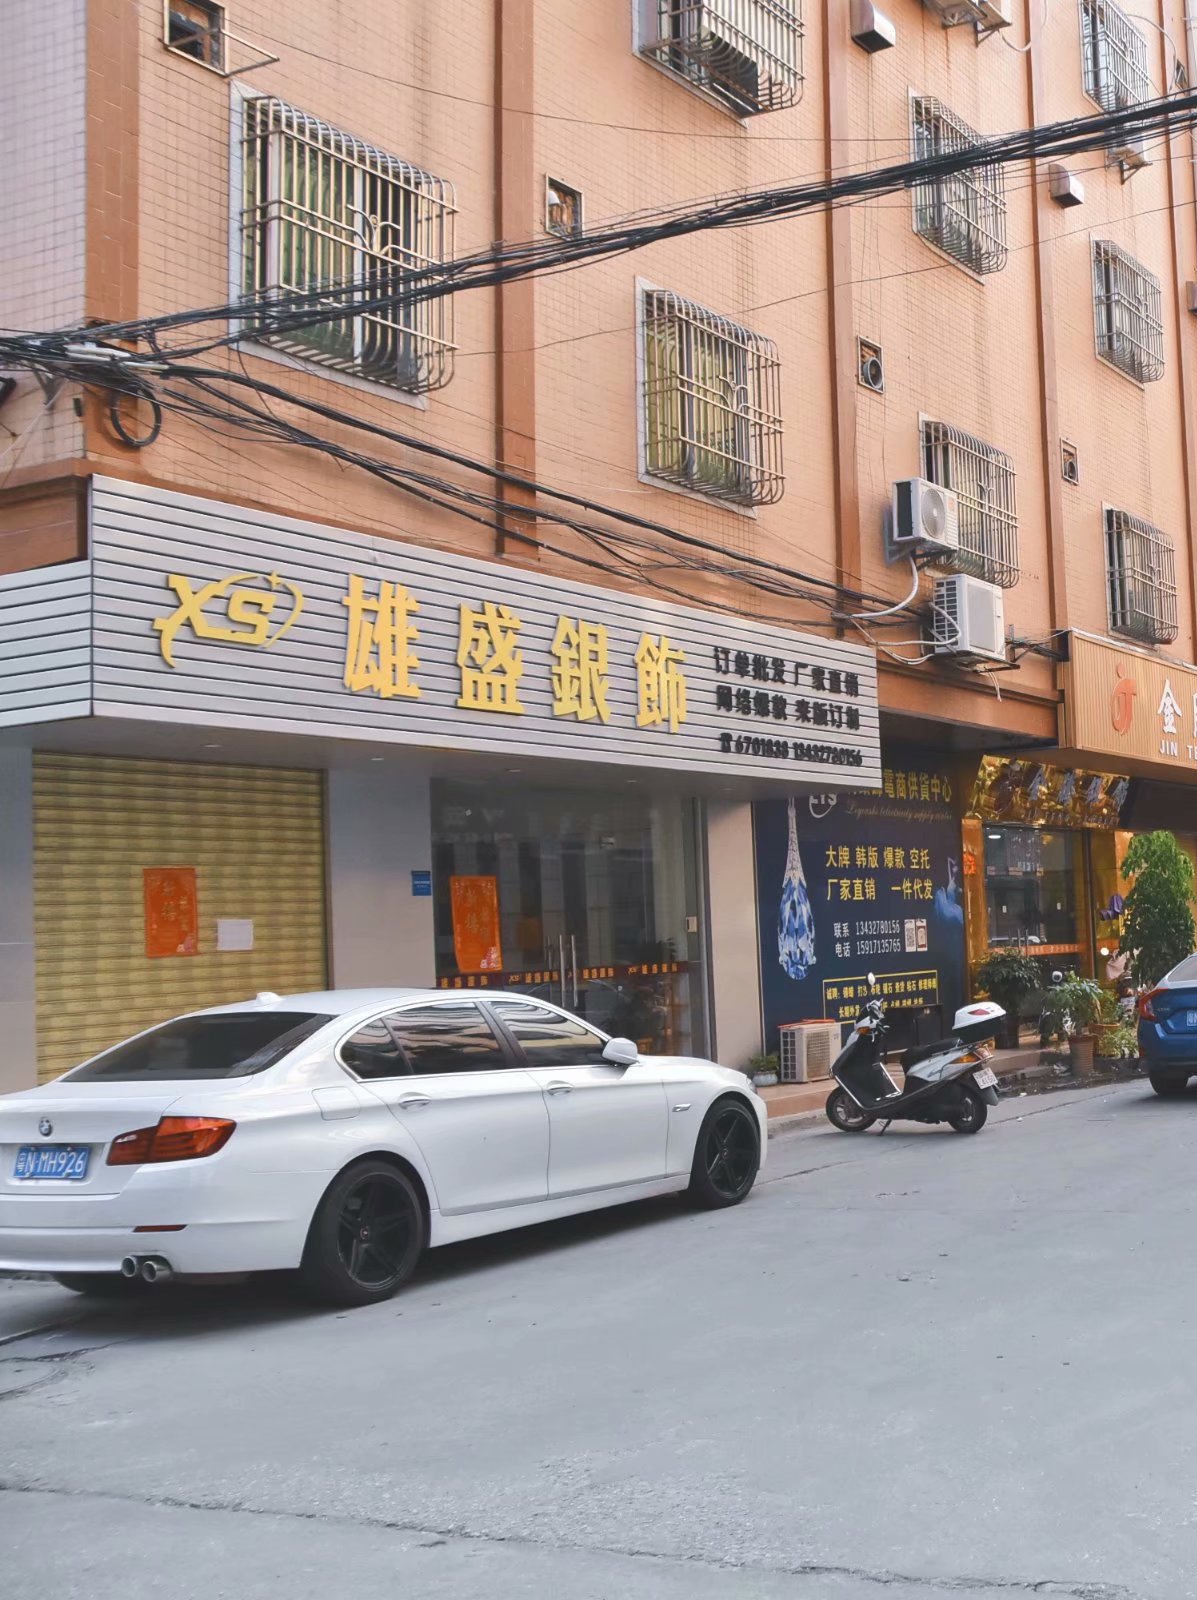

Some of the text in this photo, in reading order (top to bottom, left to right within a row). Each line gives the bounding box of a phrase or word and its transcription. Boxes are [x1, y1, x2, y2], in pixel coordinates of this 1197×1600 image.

[342, 573, 689, 736] 雄盛銀飾
[714, 646, 859, 697] 订单批发 厂家直销
[716, 684, 788, 721] 网络爆款
[1159, 739, 1178, 758] JIN
[825, 845, 930, 869] 大牌 韩版 爆款 空托
[827, 877, 934, 901] 厂家直销 一件代发
[833, 920, 900, 938] 联系 13432780156
[835, 938, 901, 958] 电话 15917135765
